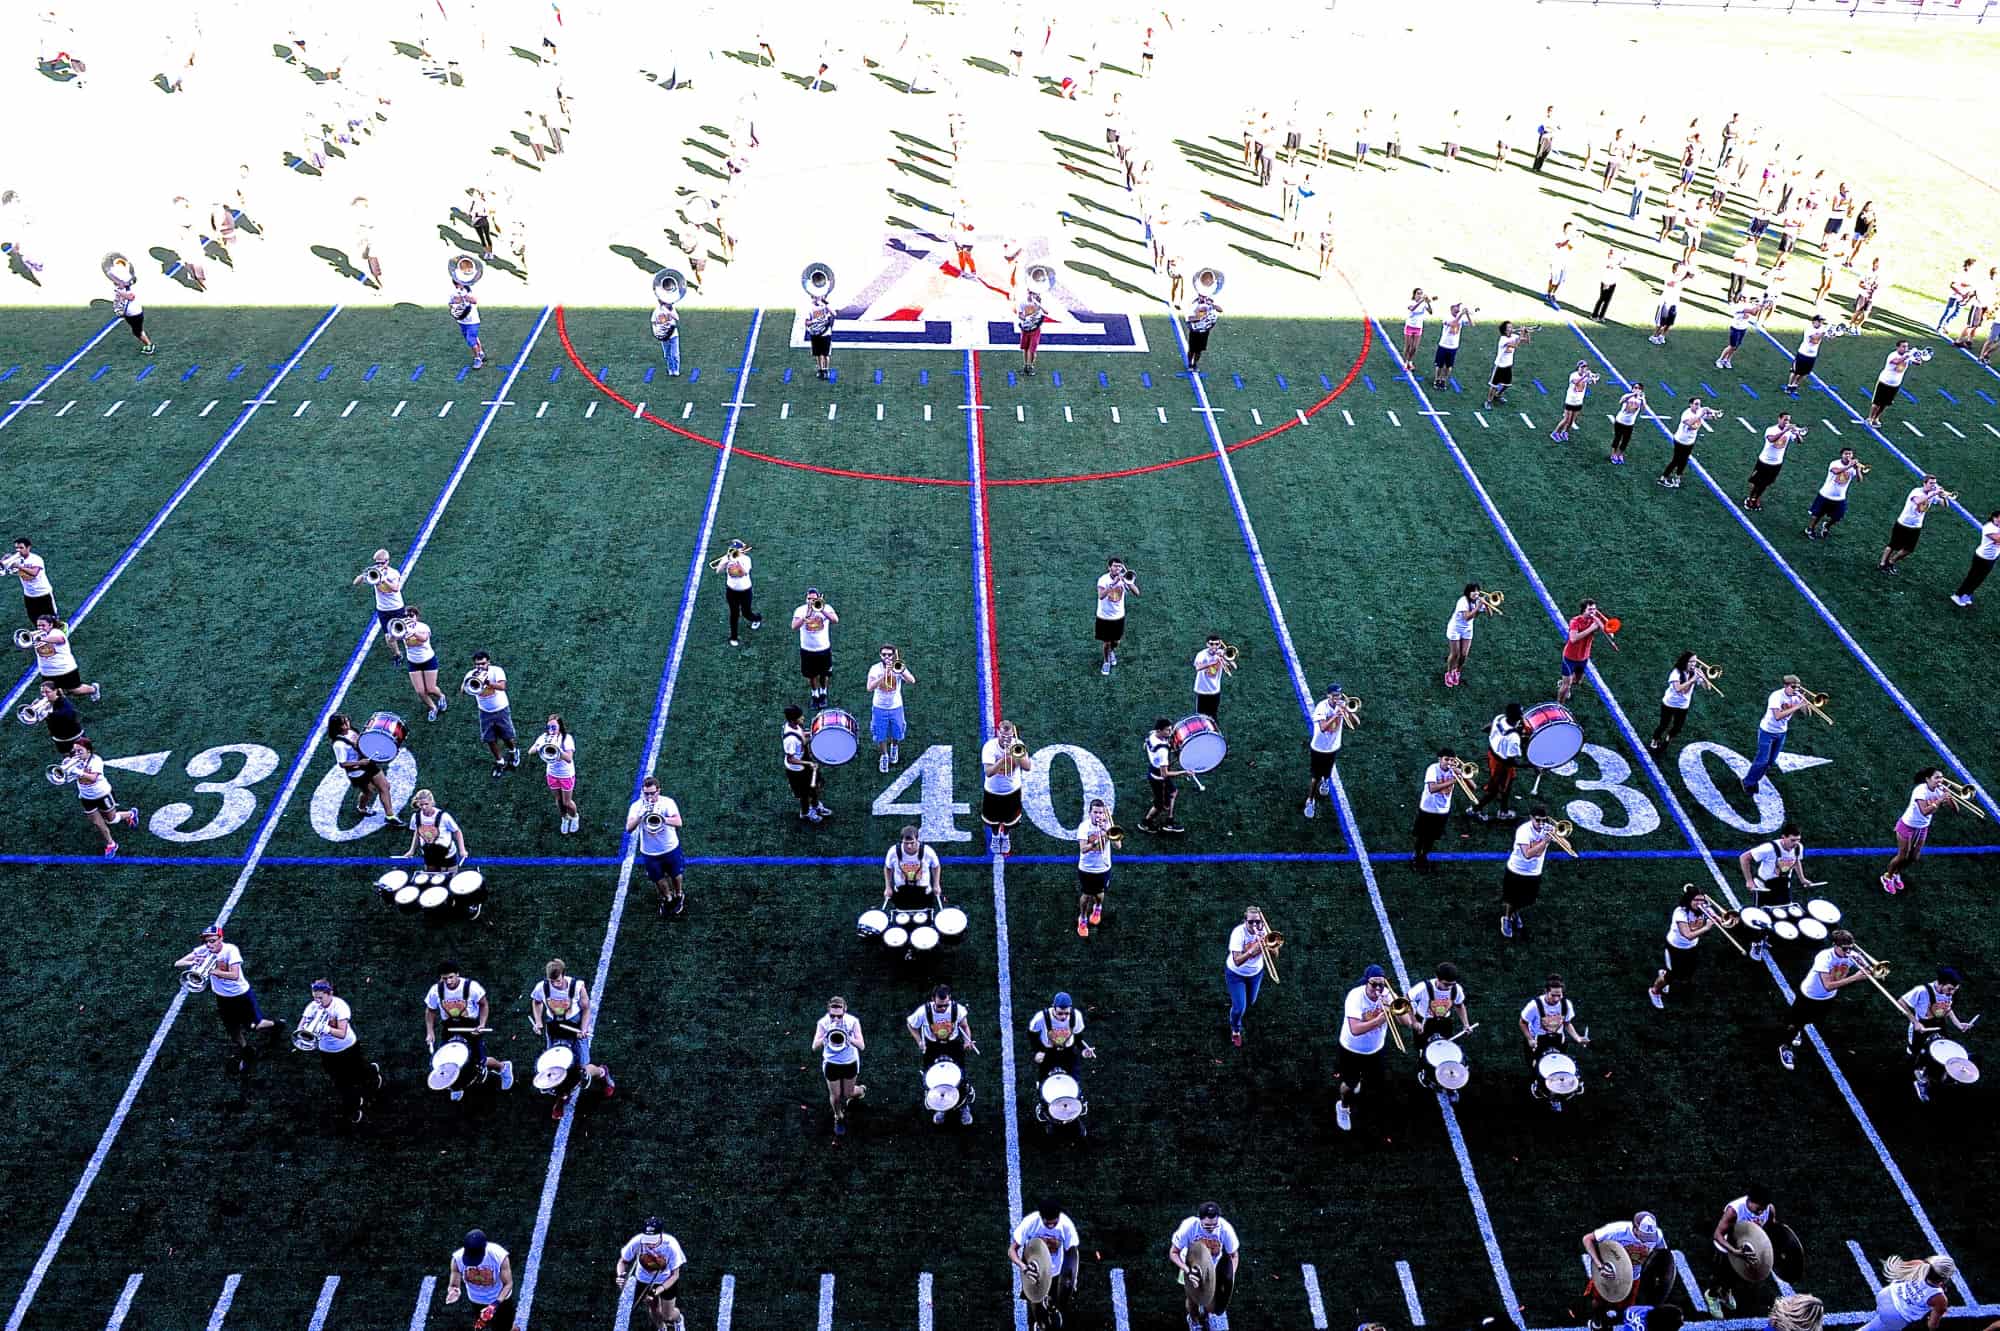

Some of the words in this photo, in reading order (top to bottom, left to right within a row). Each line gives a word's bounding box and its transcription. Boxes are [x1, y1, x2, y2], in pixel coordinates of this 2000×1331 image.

[149, 744, 418, 842] 30
[872, 744, 1115, 842] 40
[1551, 741, 1785, 837] 30
